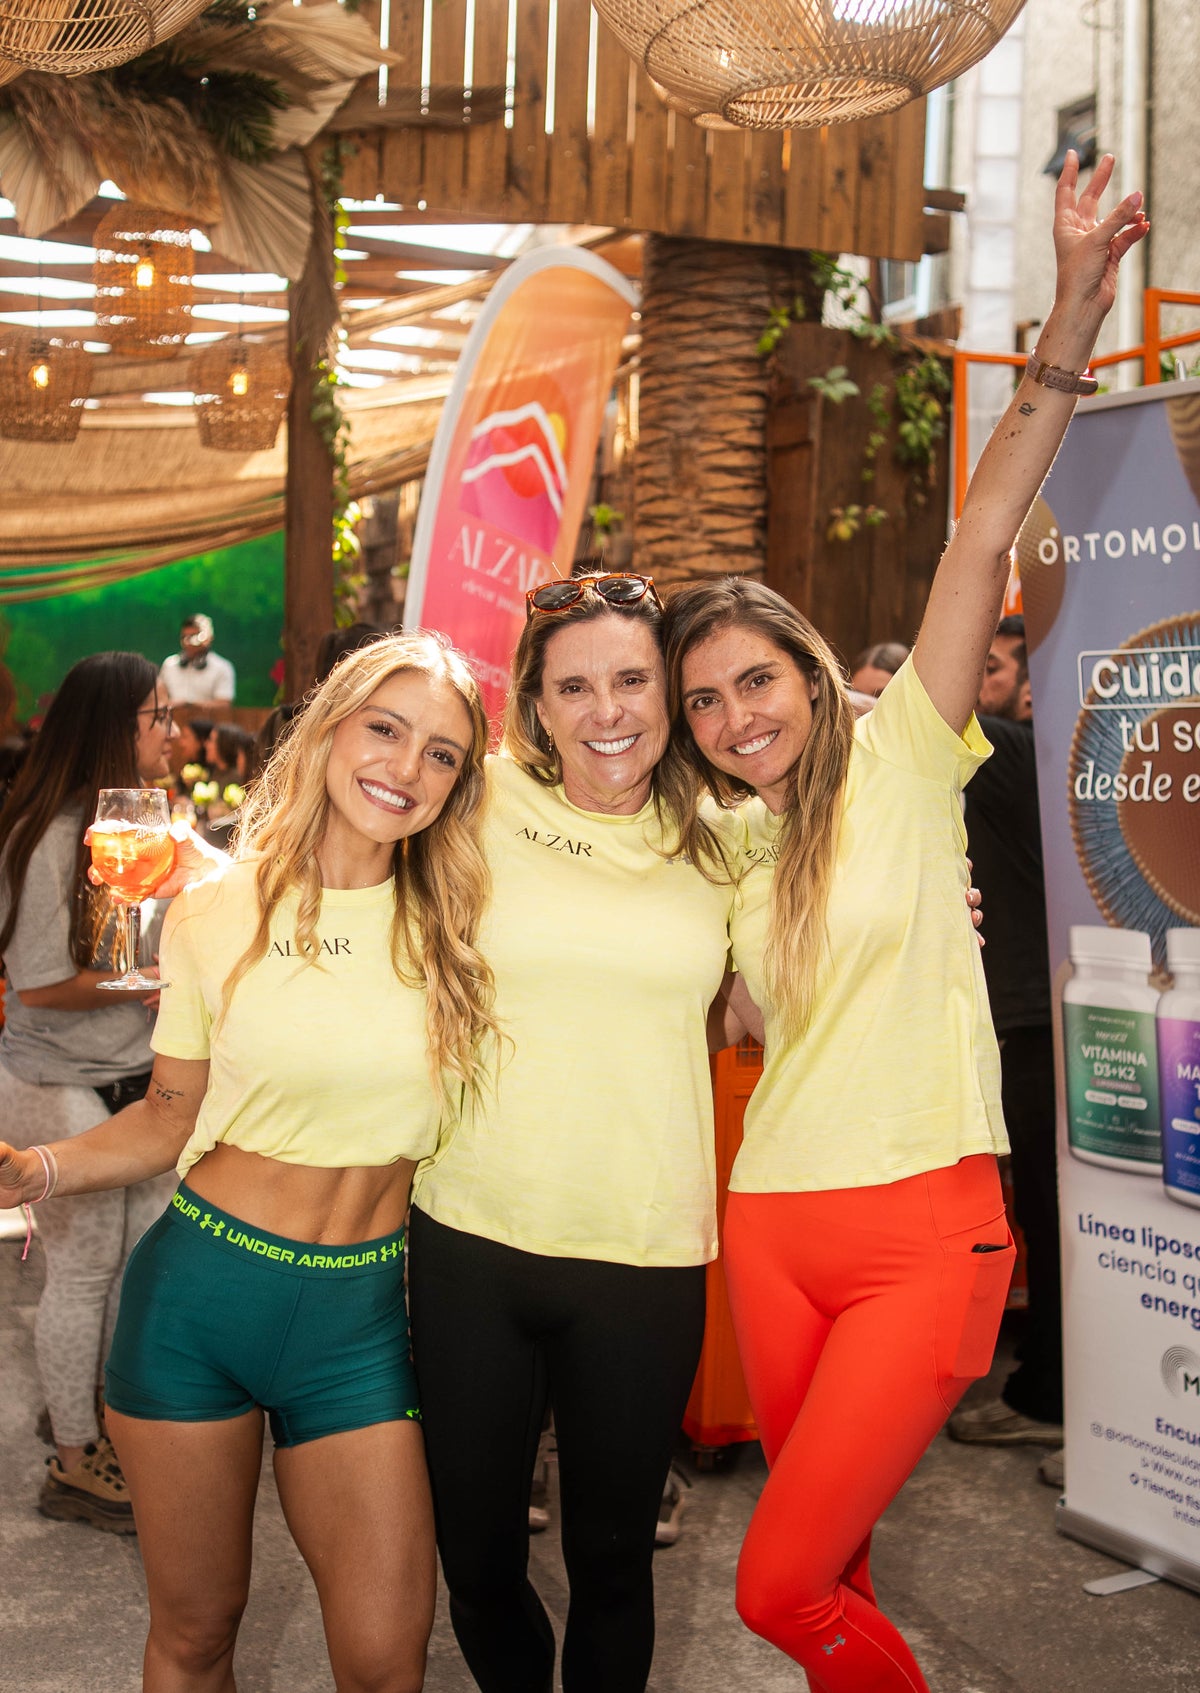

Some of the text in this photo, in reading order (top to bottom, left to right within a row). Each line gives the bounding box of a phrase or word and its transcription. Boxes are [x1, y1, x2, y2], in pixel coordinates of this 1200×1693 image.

[448, 525, 550, 593] ALZAR
[1119, 715, 1160, 752] tu
[1074, 760, 1172, 802] desde
[515, 827, 592, 857] ALZAR
[1081, 1044, 1148, 1067] VITAMINA
[1093, 1062, 1136, 1081] D3+K2
[172, 1192, 201, 1221] OUR
[227, 1228, 294, 1265] UNDER
[297, 1250, 377, 1269] ARMOUR
[1078, 1213, 1136, 1245] Línea
[1098, 1250, 1200, 1298] ciencia q
[1155, 1417, 1200, 1447] Encu
